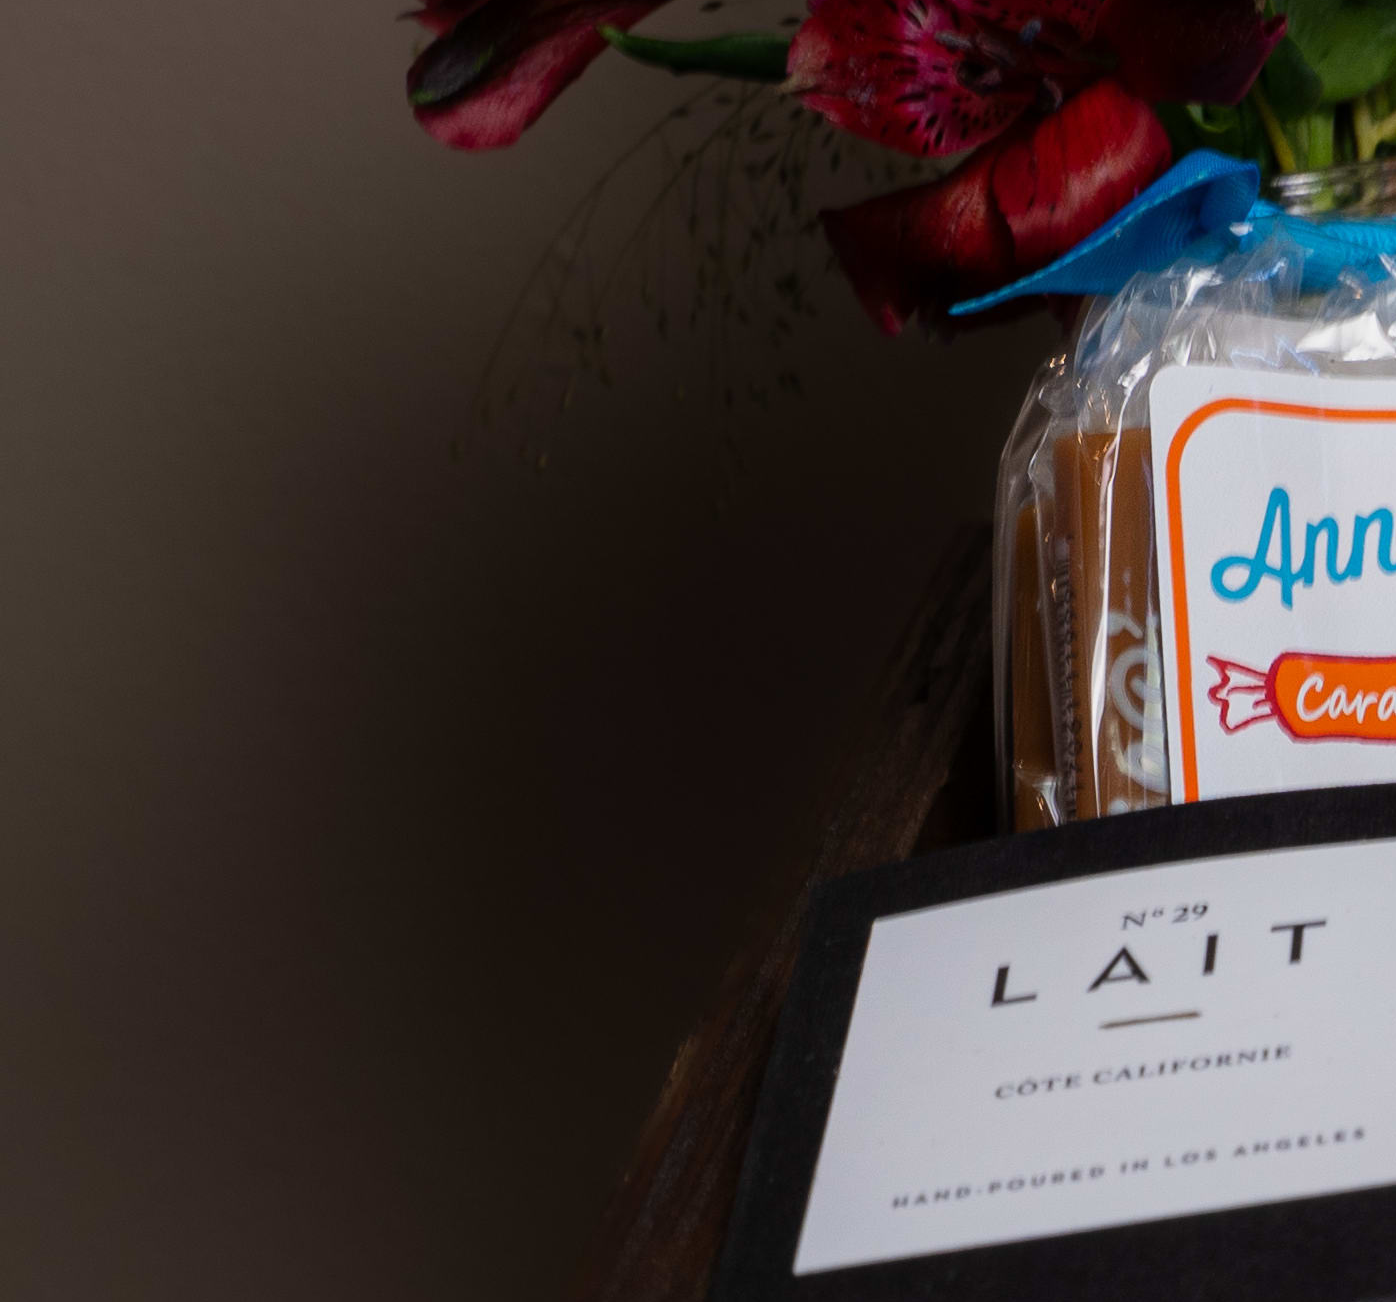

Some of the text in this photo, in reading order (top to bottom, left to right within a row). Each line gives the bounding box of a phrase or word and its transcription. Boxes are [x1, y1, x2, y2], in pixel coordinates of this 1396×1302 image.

[1171, 901, 1209, 925] 29
[991, 918, 1328, 1008] LAIT
[1093, 1044, 1293, 1085] CALIFORNIE
[892, 1127, 1368, 1210] HAND-POURED IN LOS ANGELES
